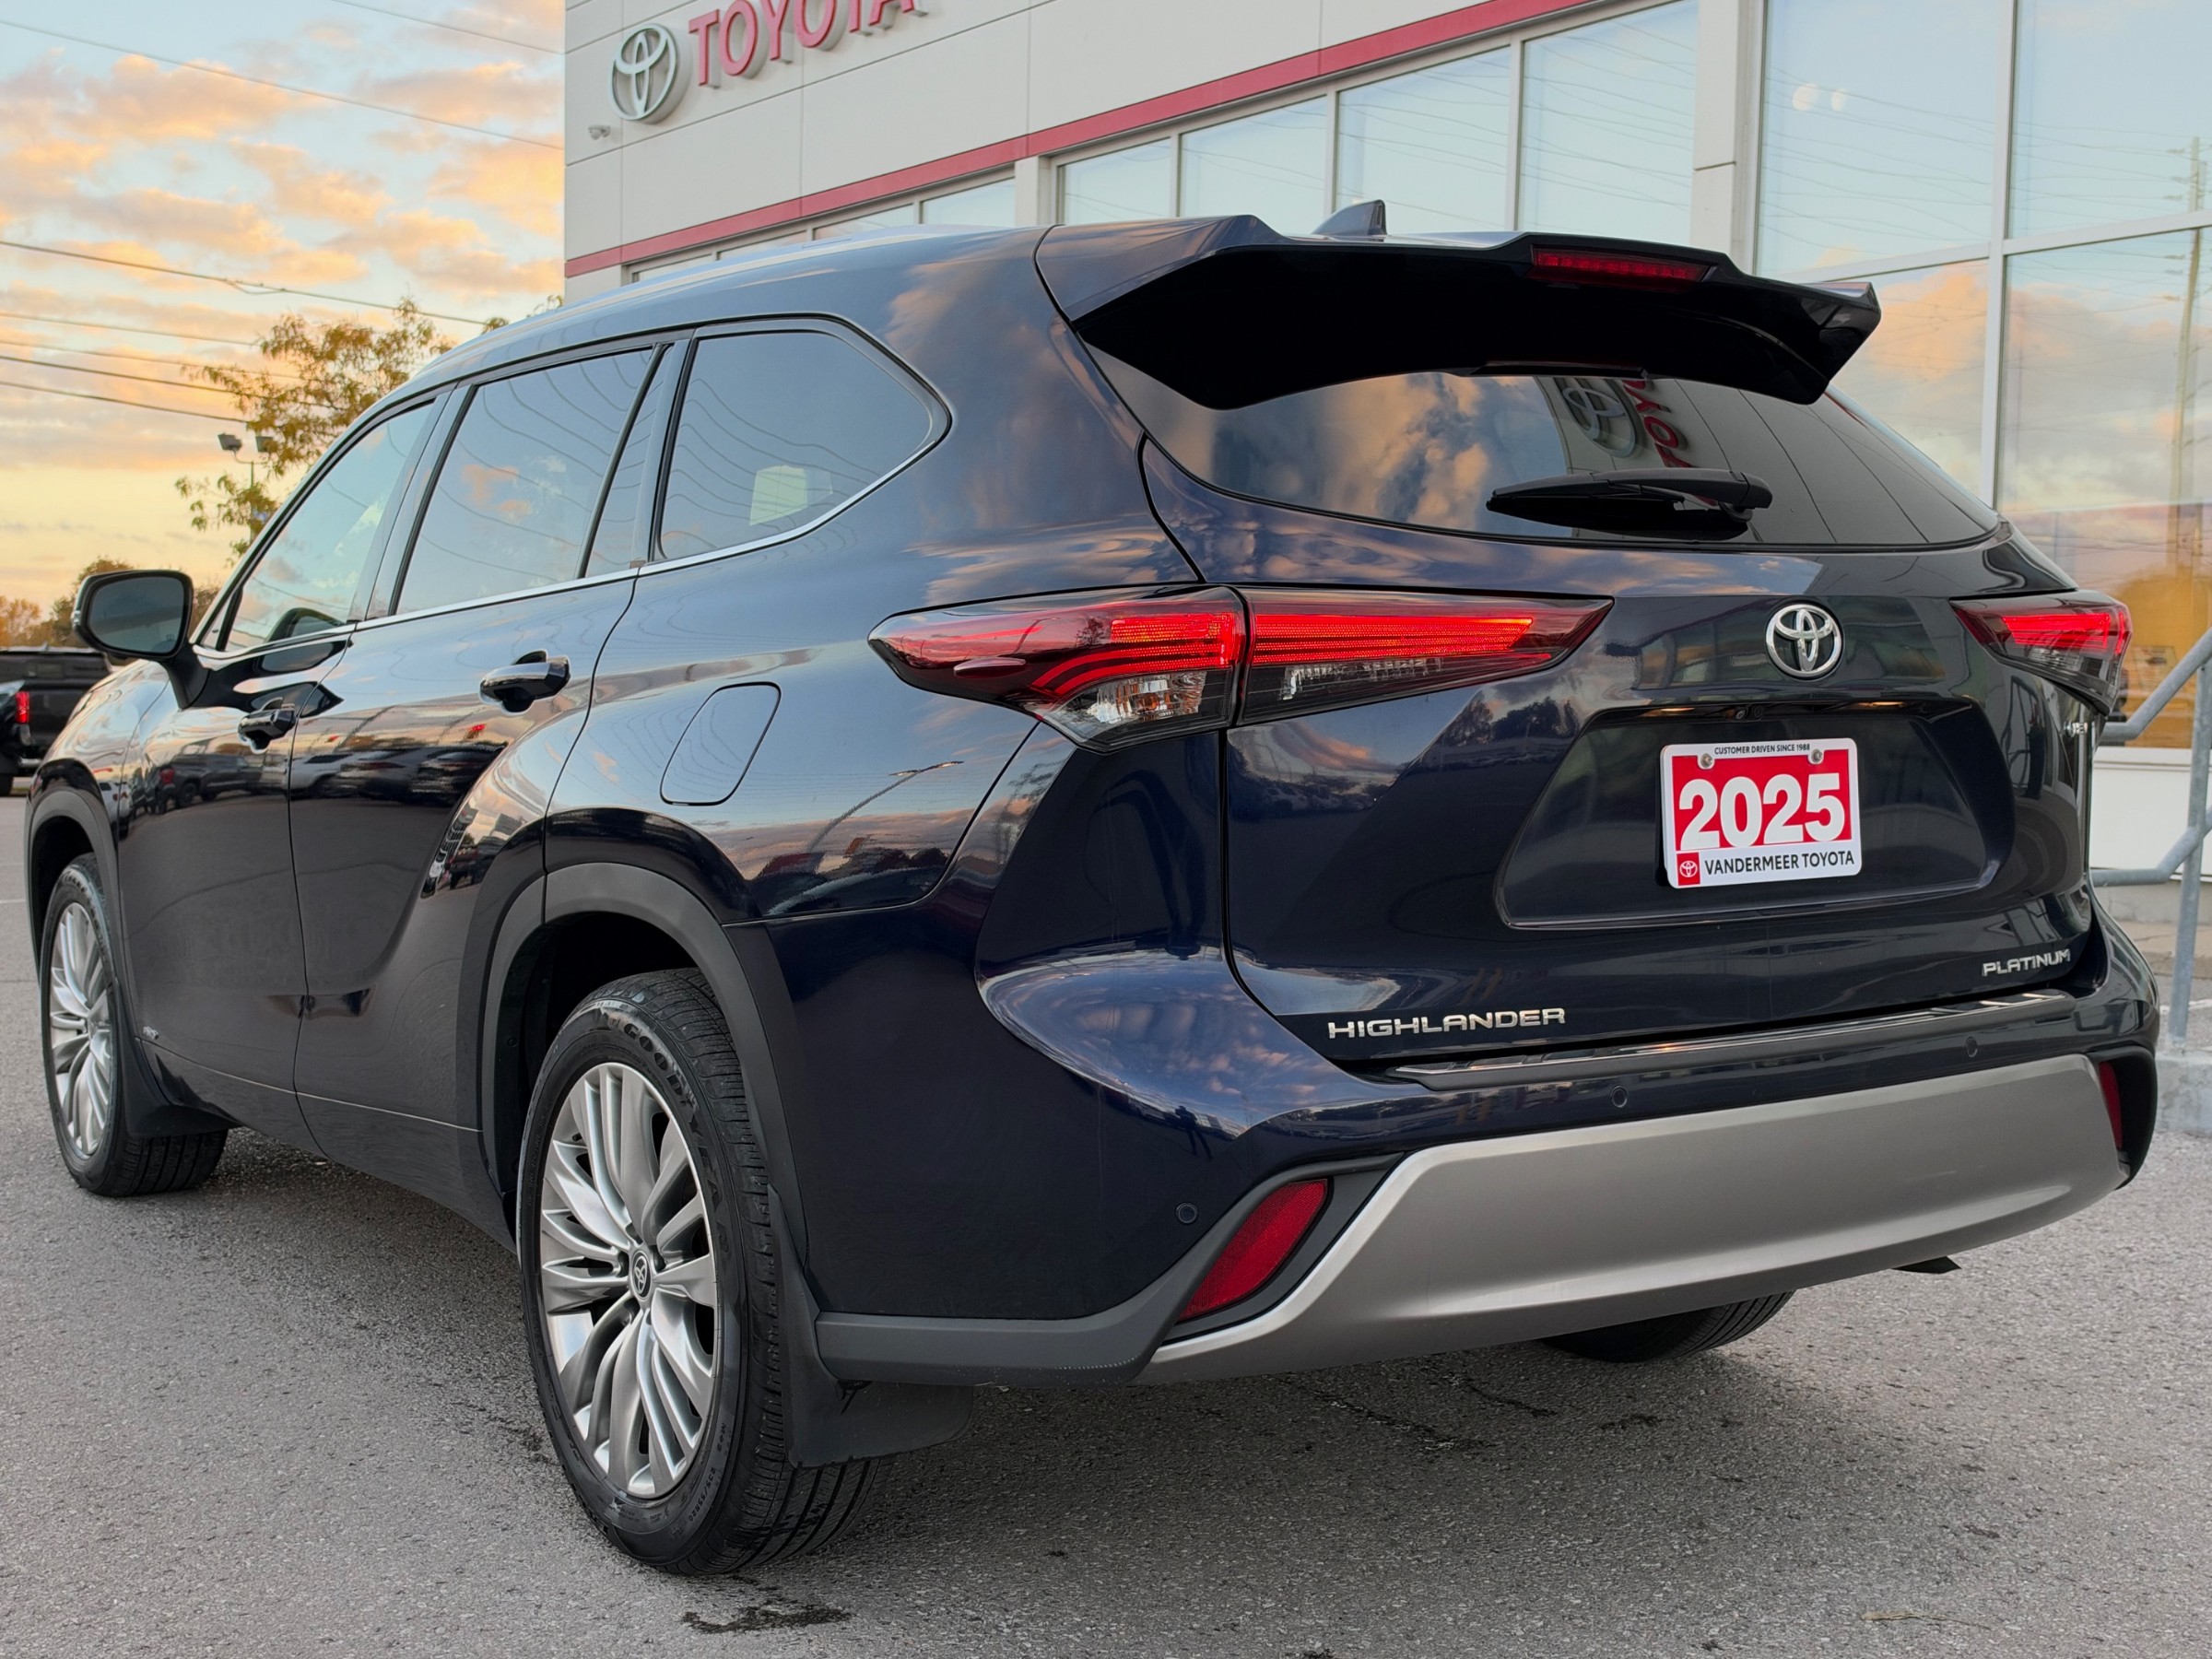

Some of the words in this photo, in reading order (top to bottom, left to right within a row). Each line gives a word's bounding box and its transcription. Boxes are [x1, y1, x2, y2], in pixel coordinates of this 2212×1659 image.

[688, 0, 918, 87] TOYO
[1714, 746, 1750, 755] CUSTOMER
[1751, 745, 1775, 753] DRIVEN
[1776, 744, 1794, 752] SINCE
[1796, 743, 1810, 751] 1988
[1678, 772, 1845, 851] 2025
[1704, 853, 1799, 876] VANDERMEER
[1802, 850, 1854, 868] TOYOTA
[1982, 948, 2071, 977] PLATINUM
[1327, 1007, 1566, 1039] HIGHLANDER
